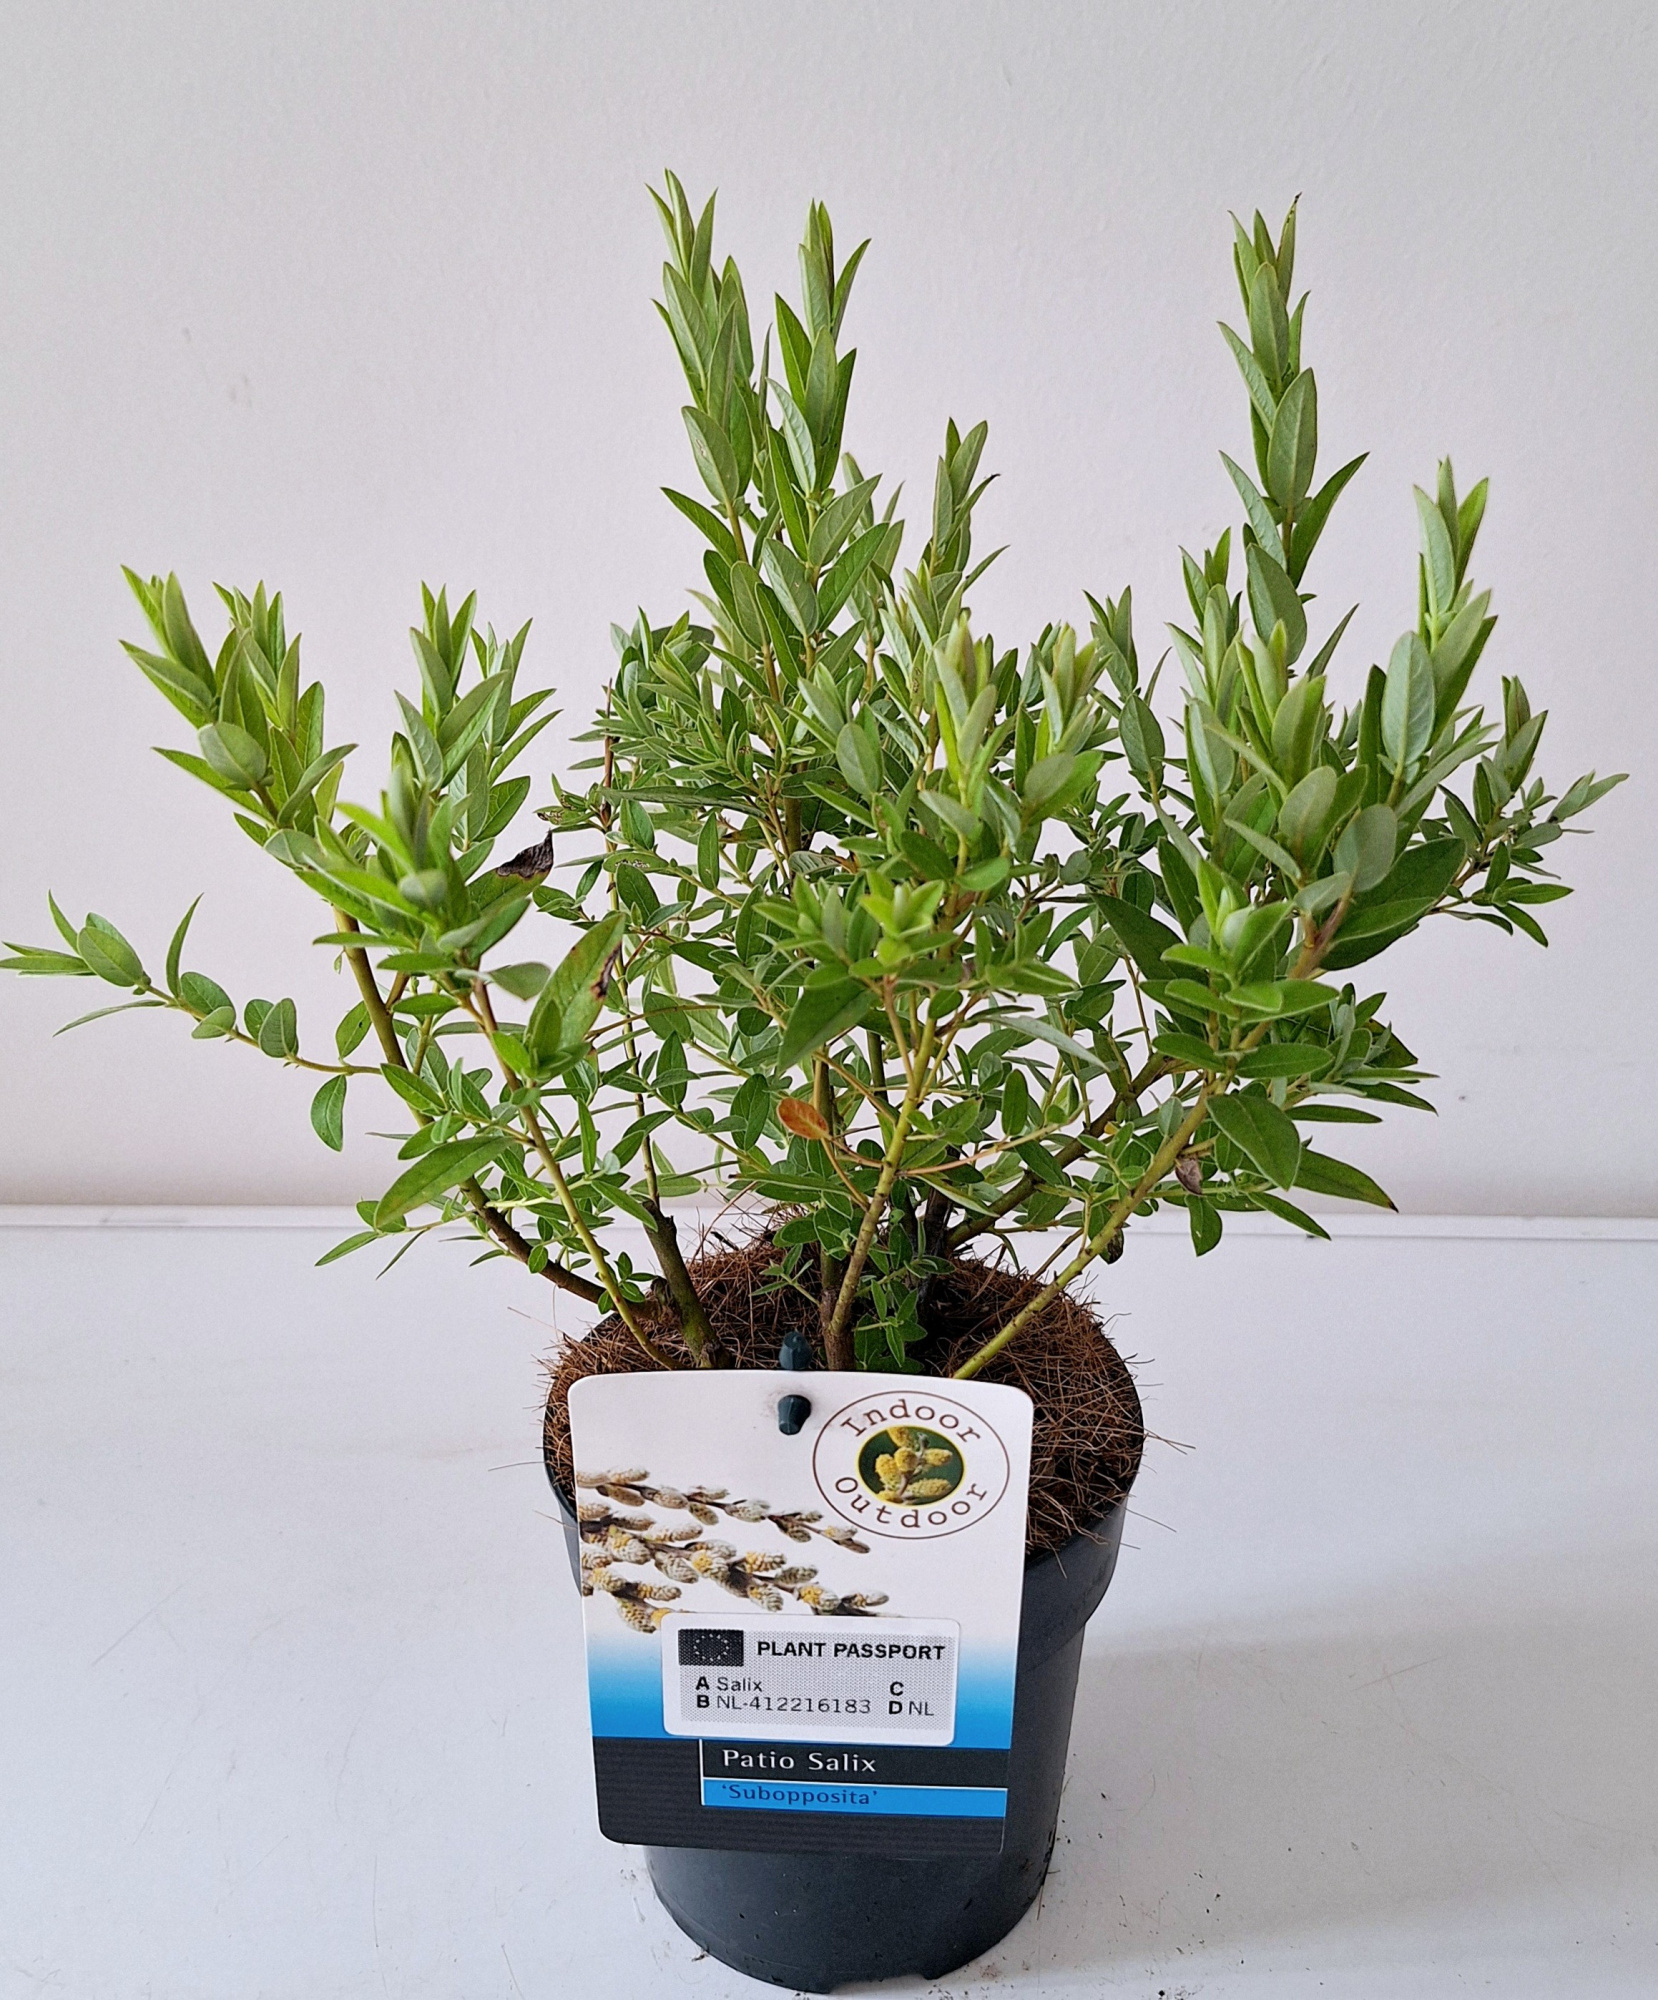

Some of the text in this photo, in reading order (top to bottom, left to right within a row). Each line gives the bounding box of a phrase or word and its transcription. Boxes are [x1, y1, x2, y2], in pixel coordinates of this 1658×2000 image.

[840, 1398, 981, 1442] Indoor
[835, 1476, 987, 1528] Outdoor
[757, 1641, 945, 1660] PLANT PASSPORT
[695, 1676, 763, 1692] A Salix
[889, 1681, 904, 1697] C
[696, 1694, 872, 1714] B NL-412216183
[888, 1700, 934, 1716] D NL
[722, 1749, 877, 1772] Patio Salix
